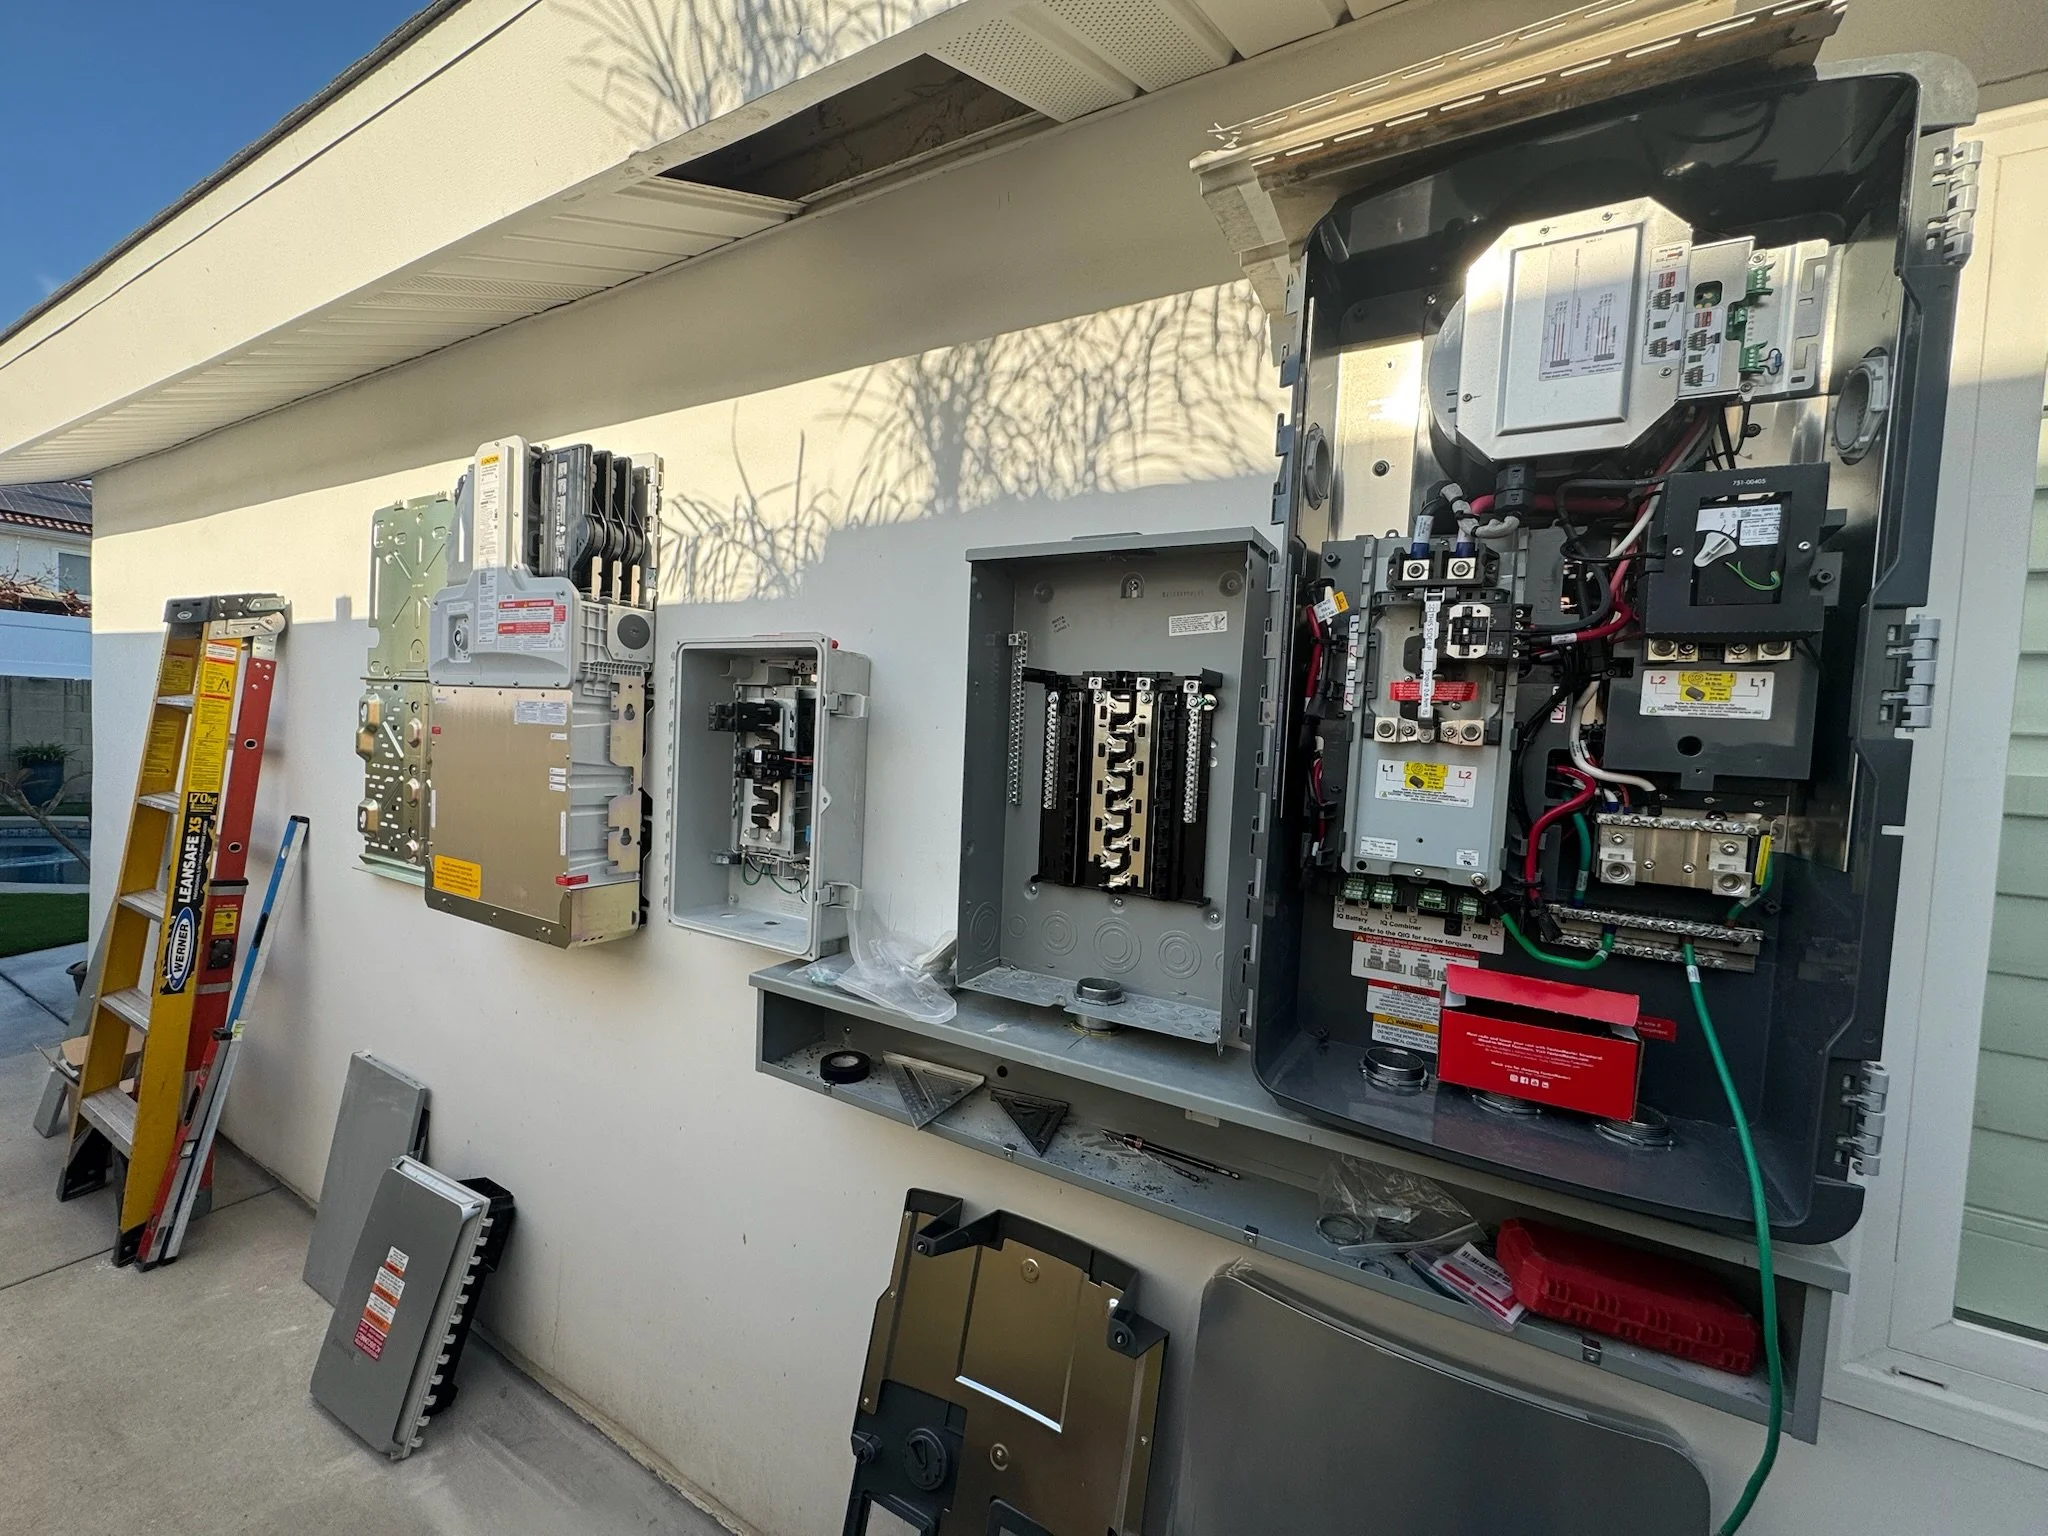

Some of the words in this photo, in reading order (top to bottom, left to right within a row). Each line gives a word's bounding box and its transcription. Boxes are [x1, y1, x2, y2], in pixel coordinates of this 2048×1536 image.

[1650, 676, 1666, 684] L2
[1751, 678, 1766, 687] L1
[1382, 764, 1393, 772] L1
[1458, 771, 1472, 779] L2
[188, 816, 202, 834] X5
[178, 835, 200, 904] LEANSAFE
[1345, 914, 1368, 924] Battery
[1389, 921, 1422, 931] Combiner
[1397, 931, 1410, 940] QIG
[1445, 938, 1474, 949] torques.
[174, 923, 189, 974] WERNER
[1395, 1019, 1423, 1028] WARNING
[1381, 1035, 1405, 1044] ELECTRICAL
